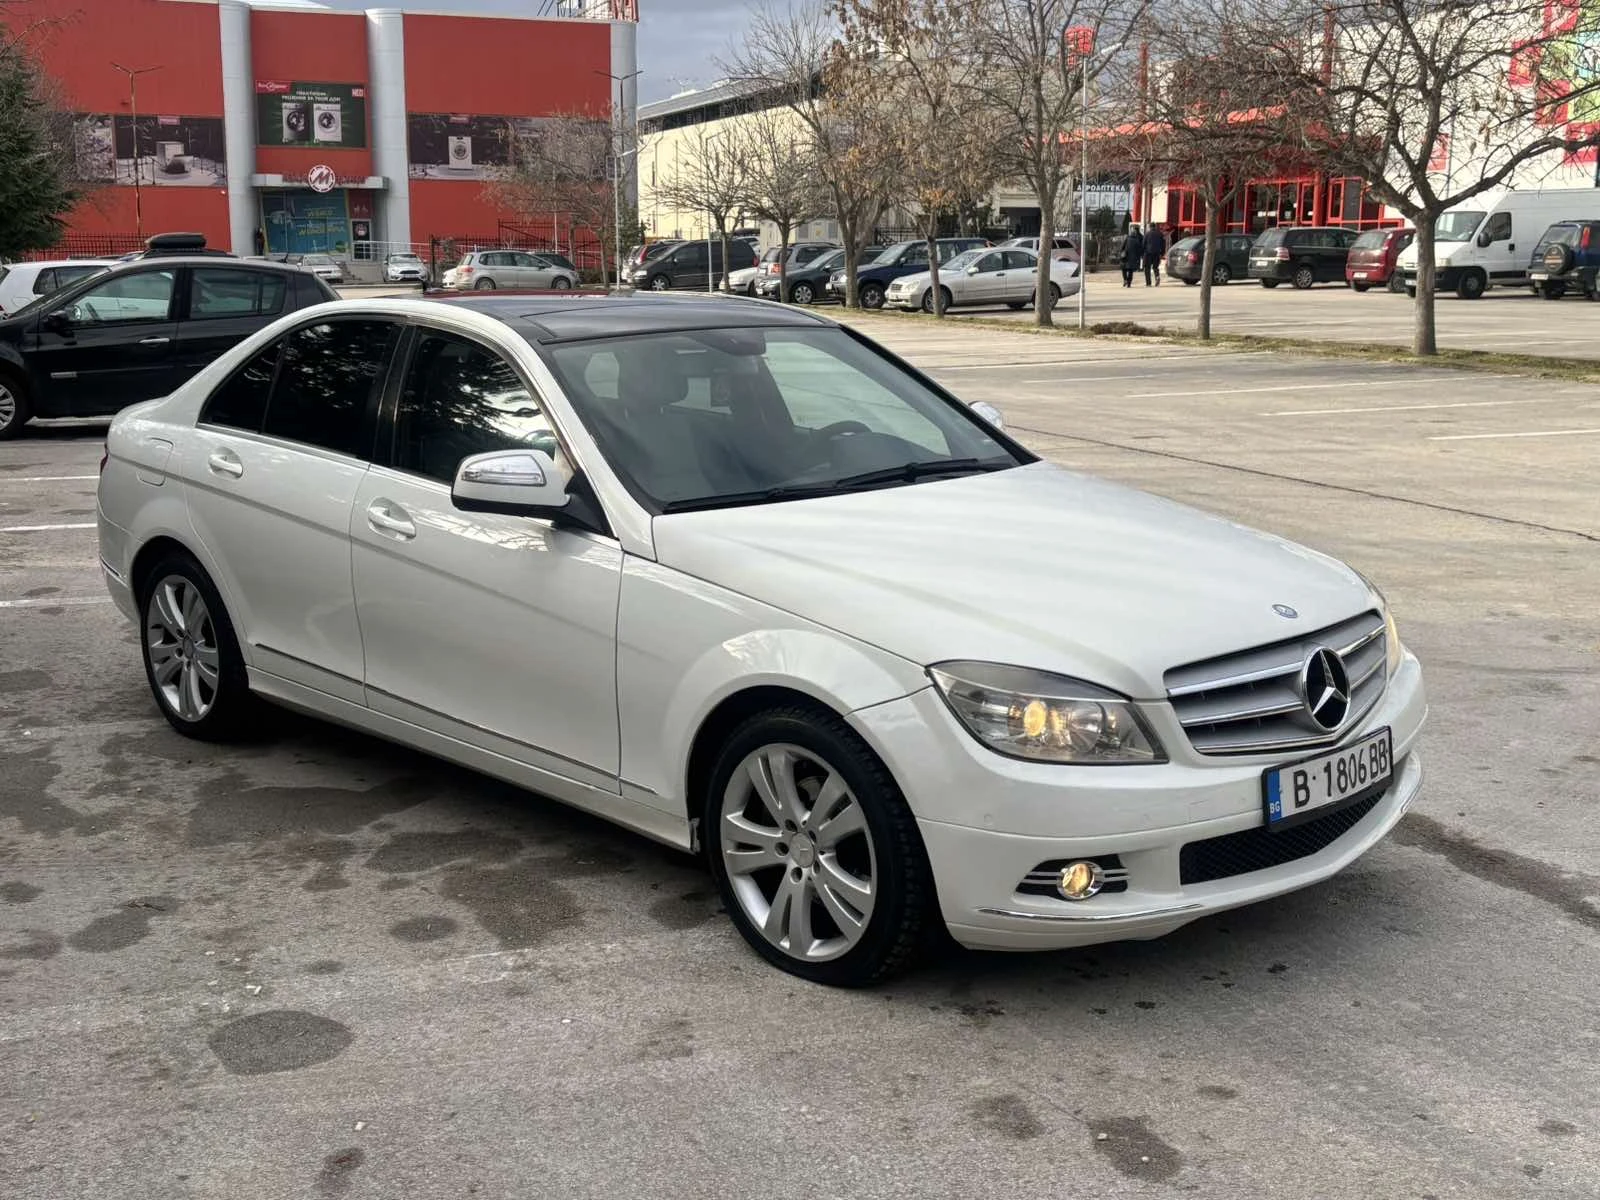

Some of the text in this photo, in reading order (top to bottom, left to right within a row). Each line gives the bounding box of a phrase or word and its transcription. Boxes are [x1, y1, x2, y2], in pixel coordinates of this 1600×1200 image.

[1077, 184, 1126, 192] АРОАПТЕКА
[1293, 738, 1388, 809] B 1806 BB
[1269, 801, 1281, 814] BG
